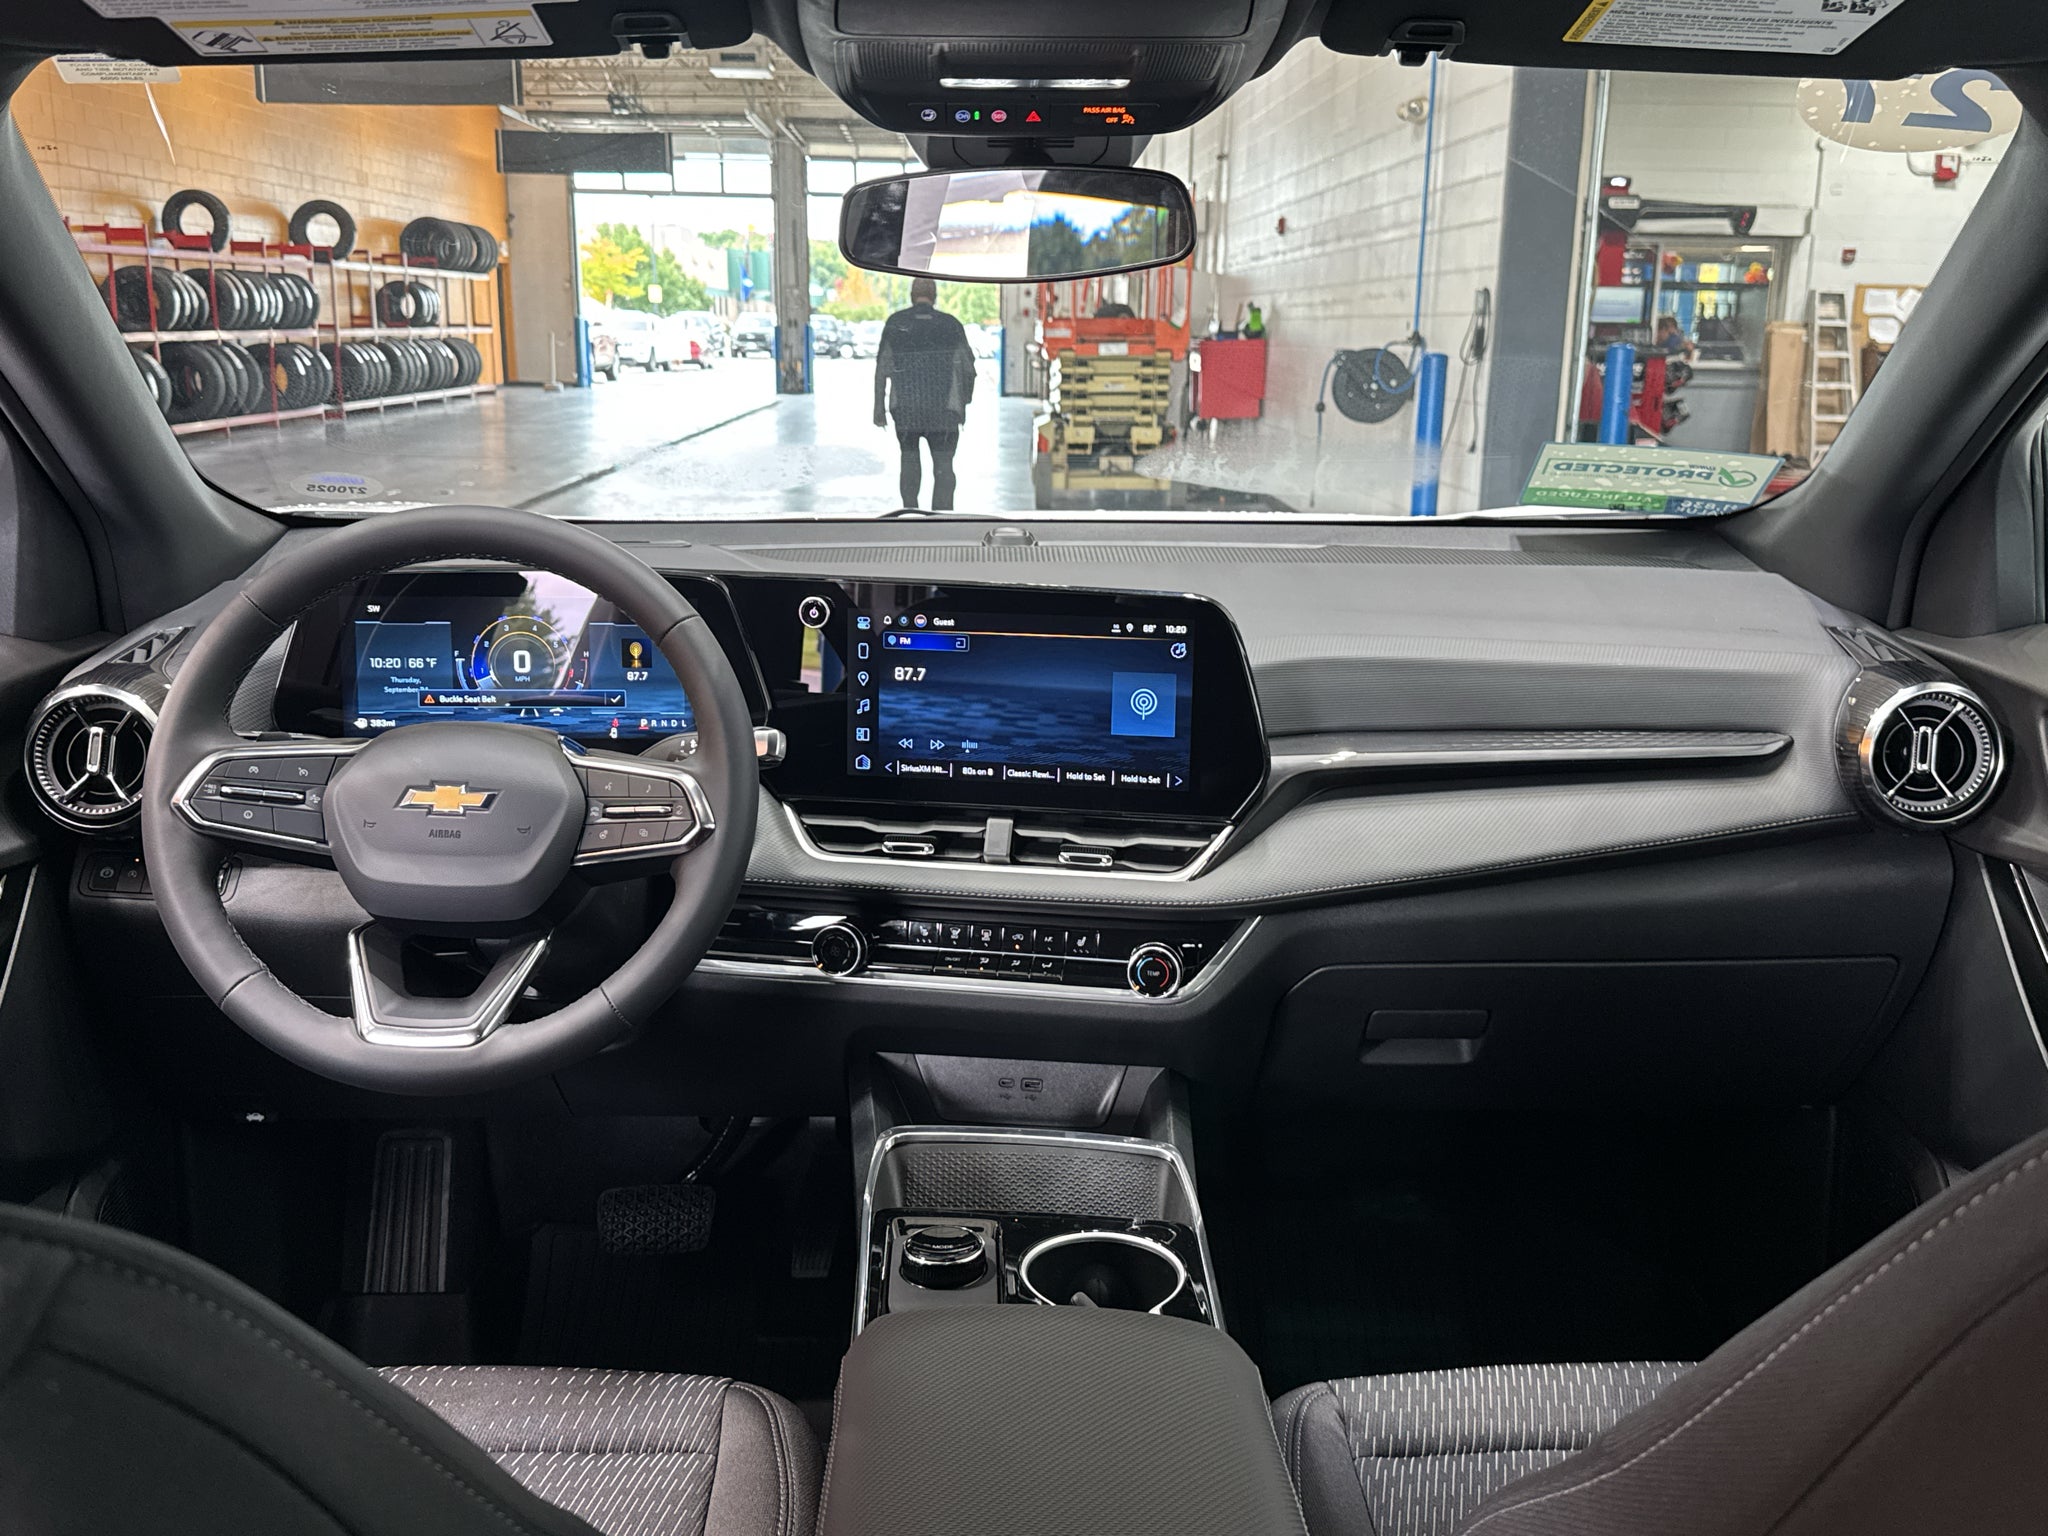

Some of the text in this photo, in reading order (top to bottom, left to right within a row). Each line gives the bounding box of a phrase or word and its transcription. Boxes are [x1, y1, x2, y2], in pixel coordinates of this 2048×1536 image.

[367, 604, 381, 613] SW
[933, 617, 955, 626] Guest
[1165, 625, 1187, 634] 10:20
[899, 637, 912, 645] FM
[369, 657, 401, 669] 10:20
[408, 657, 424, 669] 66
[513, 650, 531, 673] 0
[626, 671, 648, 681] 87.7
[894, 667, 927, 681] 87.7
[390, 676, 422, 685] Thursday,
[383, 686, 418, 695] September
[439, 695, 497, 704] Buckle Seat Belt
[640, 719, 648, 727] P
[651, 719, 658, 727] R
[661, 719, 668, 727] N
[671, 719, 678, 727] D
[900, 764, 931, 773] SiriusXM
[977, 768, 987, 776] on
[1007, 768, 1031, 777] Classic
[1066, 771, 1083, 780] Hold
[1093, 773, 1106, 781] Set
[1121, 774, 1138, 782] Hold
[1148, 776, 1161, 784] Set
[428, 829, 462, 839] AIRBAG
